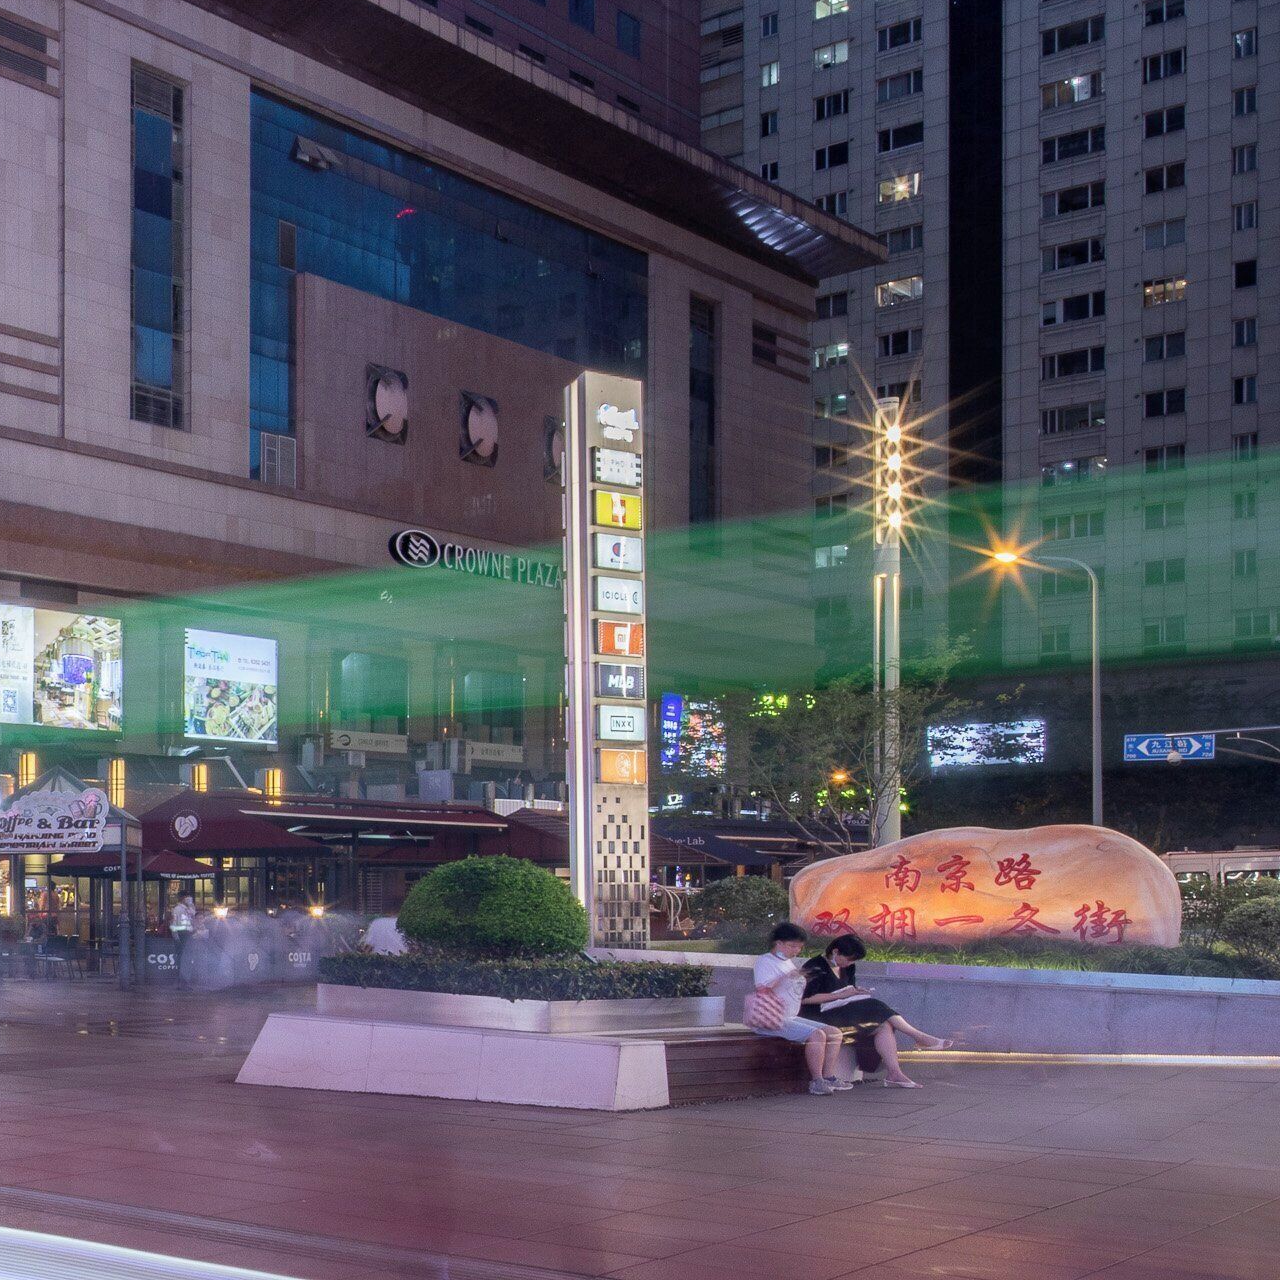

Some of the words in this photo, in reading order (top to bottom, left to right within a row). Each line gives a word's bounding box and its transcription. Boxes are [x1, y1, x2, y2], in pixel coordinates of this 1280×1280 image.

[443, 542, 512, 580] CROWNE
[517, 556, 563, 589] PLAZA
[36, 818, 52, 830] &
[56, 815, 100, 830] Bar
[884, 852, 1041, 894] 南京路
[288, 952, 312, 964] COSTA
